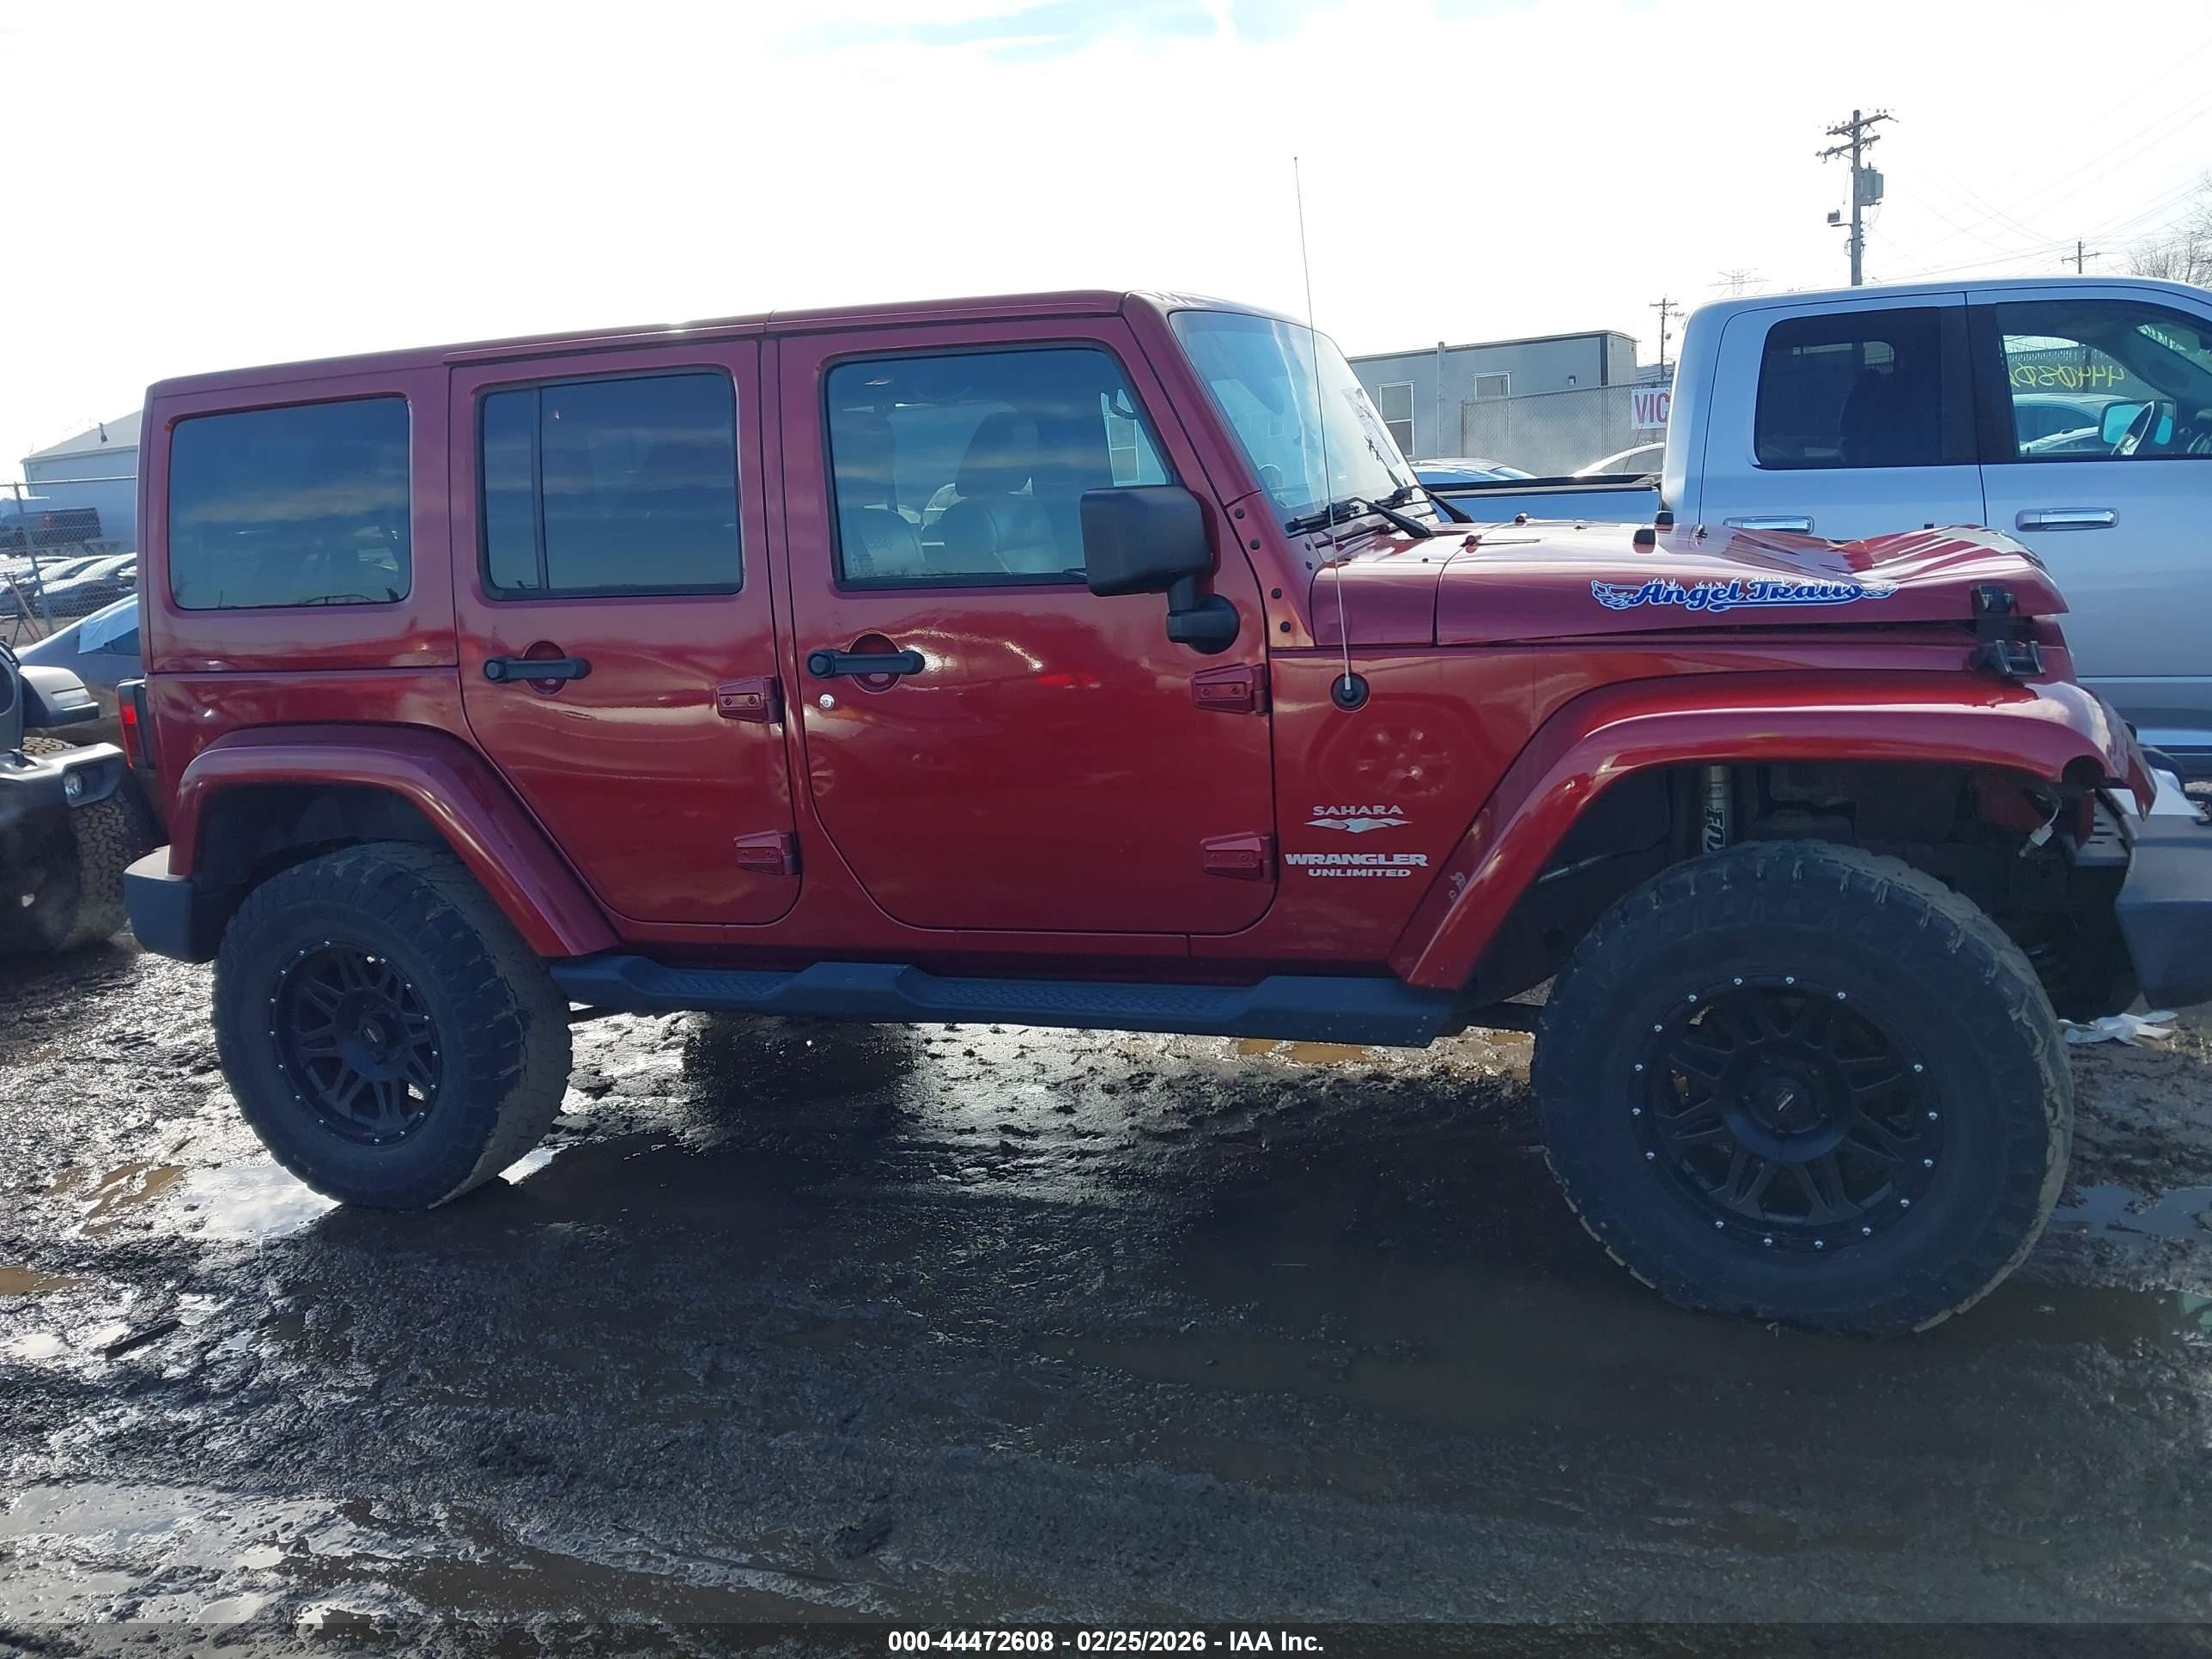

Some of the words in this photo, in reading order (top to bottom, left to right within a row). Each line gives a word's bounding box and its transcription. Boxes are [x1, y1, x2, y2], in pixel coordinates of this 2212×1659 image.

[1634, 392, 1669, 423] VIC
[1628, 579, 1745, 611] Angel
[1312, 805, 1404, 816] SAHARA
[1285, 854, 1429, 866] WRANGLER
